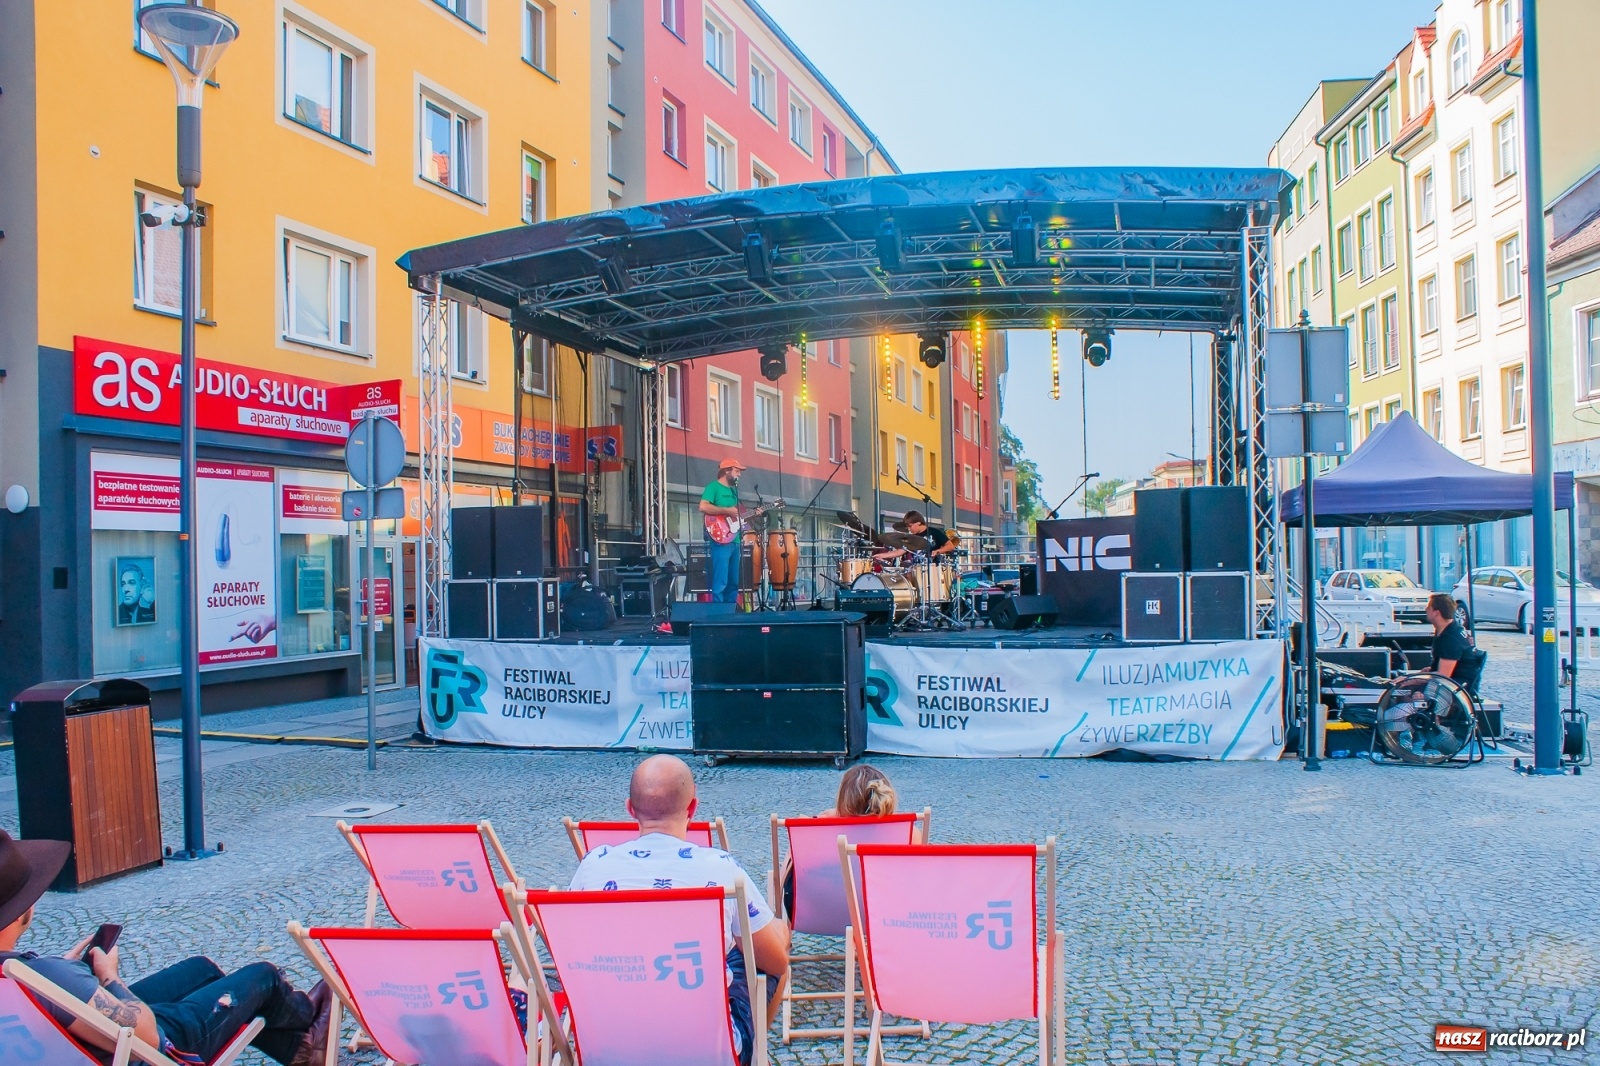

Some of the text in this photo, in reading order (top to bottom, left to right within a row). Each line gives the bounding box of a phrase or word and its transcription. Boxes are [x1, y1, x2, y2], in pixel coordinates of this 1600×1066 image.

[92, 351, 162, 412] as
[366, 386, 382, 399] as
[250, 411, 342, 434] aparaty słuchowe
[139, 484, 180, 494] testowanie
[289, 492, 311, 501] baterie
[98, 494, 136, 504] aparatów
[294, 504, 318, 513] badanie
[213, 581, 260, 594] APARATY
[207, 594, 266, 608] SŁUCHOWE
[503, 667, 576, 686] FESTIWAL
[917, 675, 1006, 693] FESTIWAL
[503, 686, 611, 705] RACIBORSKIEJ
[501, 704, 547, 720] ULICY
[917, 695, 1049, 713] RACIBORSKIEJ
[918, 713, 969, 730] ULICY
